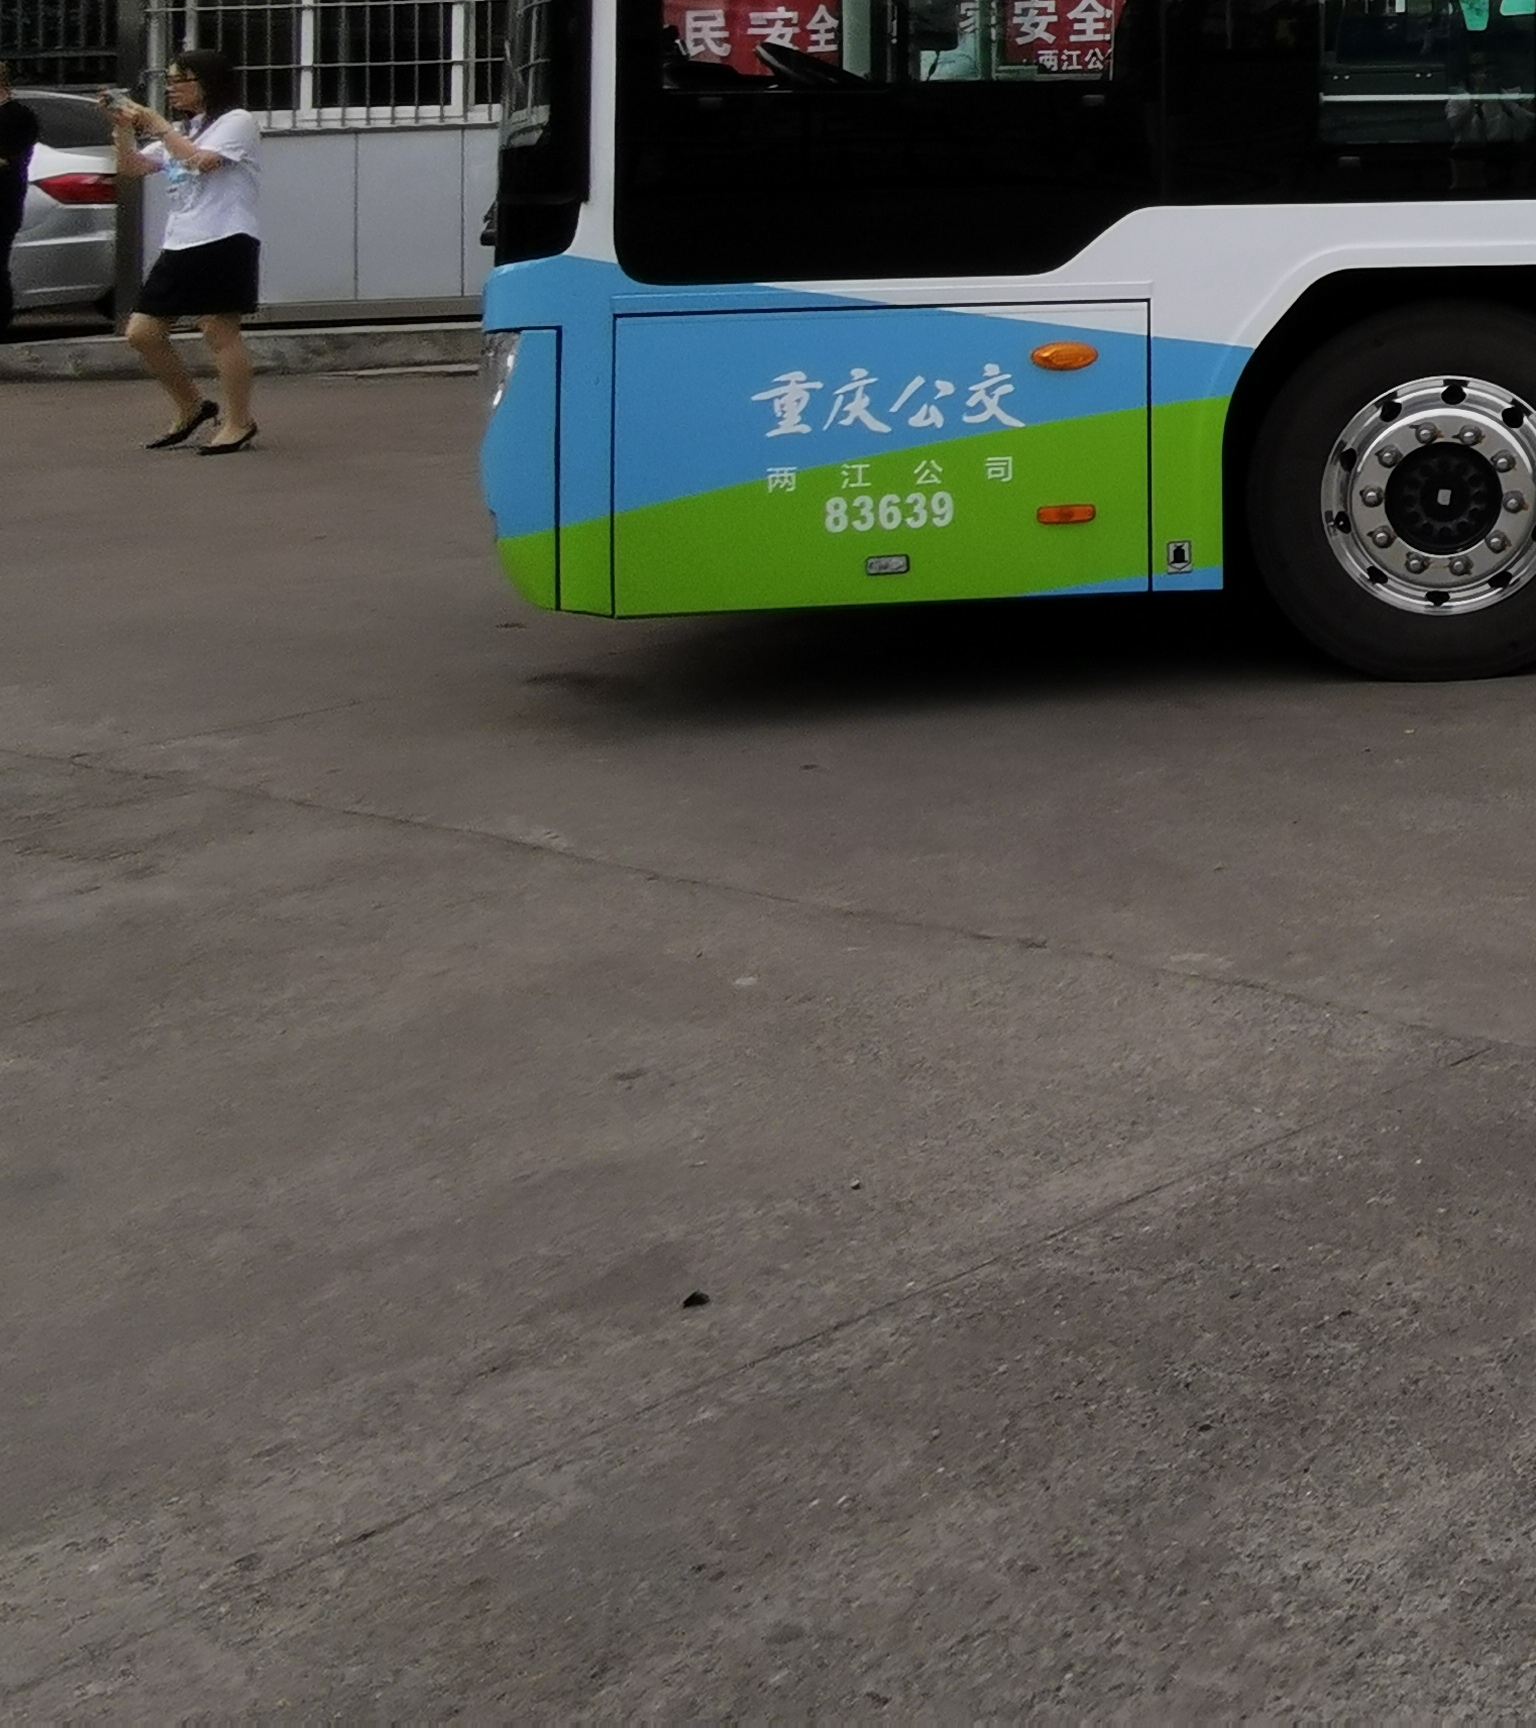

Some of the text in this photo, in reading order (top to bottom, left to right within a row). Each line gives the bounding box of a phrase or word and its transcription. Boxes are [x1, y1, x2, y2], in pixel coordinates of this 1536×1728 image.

[750, 363, 1025, 439] 重庆公交
[824, 491, 954, 533] 83639
